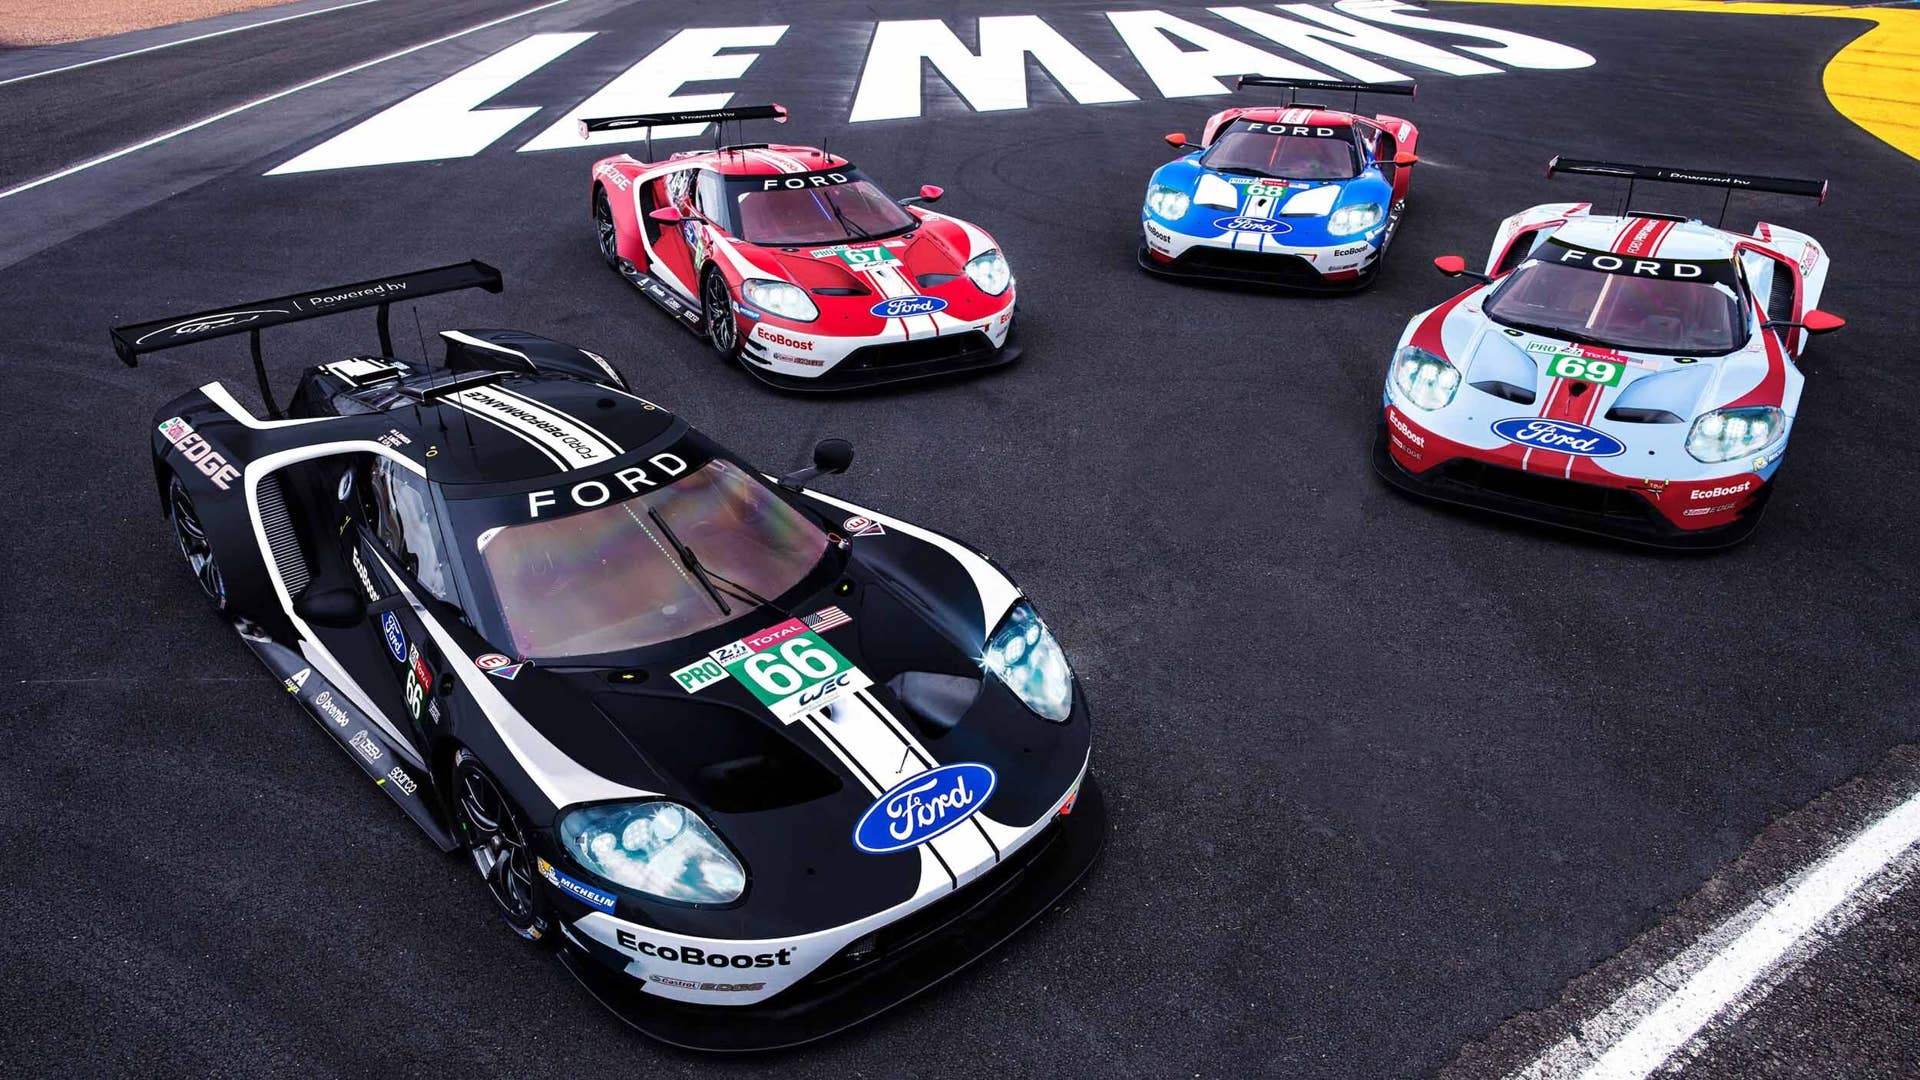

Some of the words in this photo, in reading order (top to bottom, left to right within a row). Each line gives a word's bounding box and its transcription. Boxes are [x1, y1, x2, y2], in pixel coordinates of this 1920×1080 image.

[262, 25, 790, 175] LE
[849, 0, 1596, 123] MANS
[1247, 122, 1334, 138] FORD
[607, 164, 632, 191] EDGE
[763, 173, 848, 191] FORD
[1246, 184, 1283, 197] 68
[1669, 172, 1730, 184] Powered
[1227, 218, 1277, 232] Ford
[844, 247, 885, 264] 67
[1560, 248, 1702, 278] FORD
[309, 283, 387, 307] Powered
[886, 297, 934, 316] Ford
[757, 327, 814, 351] EcoBoost
[1530, 343, 1557, 353] PRO
[1555, 356, 1616, 383] 69
[1584, 350, 1625, 364] TOTAL
[463, 390, 568, 439] PERFORMANCE
[1390, 409, 1425, 449] EcoBoost
[562, 435, 600, 460] FORD
[1516, 421, 1600, 452] Ford
[174, 432, 242, 490] EDGE
[527, 452, 688, 518] FORD
[1690, 480, 1751, 500] EcoBoost
[352, 545, 381, 602] EcoBoost
[385, 614, 403, 655] Ford
[749, 625, 804, 648] TOTAL
[676, 661, 723, 690] PRO
[743, 637, 839, 696] 66
[406, 669, 424, 720] 66
[798, 672, 851, 707] WEC
[320, 697, 350, 728] brembo
[389, 766, 418, 795] sparco
[886, 775, 974, 841] Ford
[560, 877, 615, 908] MICHELIN
[615, 928, 791, 969] EcoBoost
[661, 976, 698, 989] Castrol
[700, 981, 768, 993] EDGE
